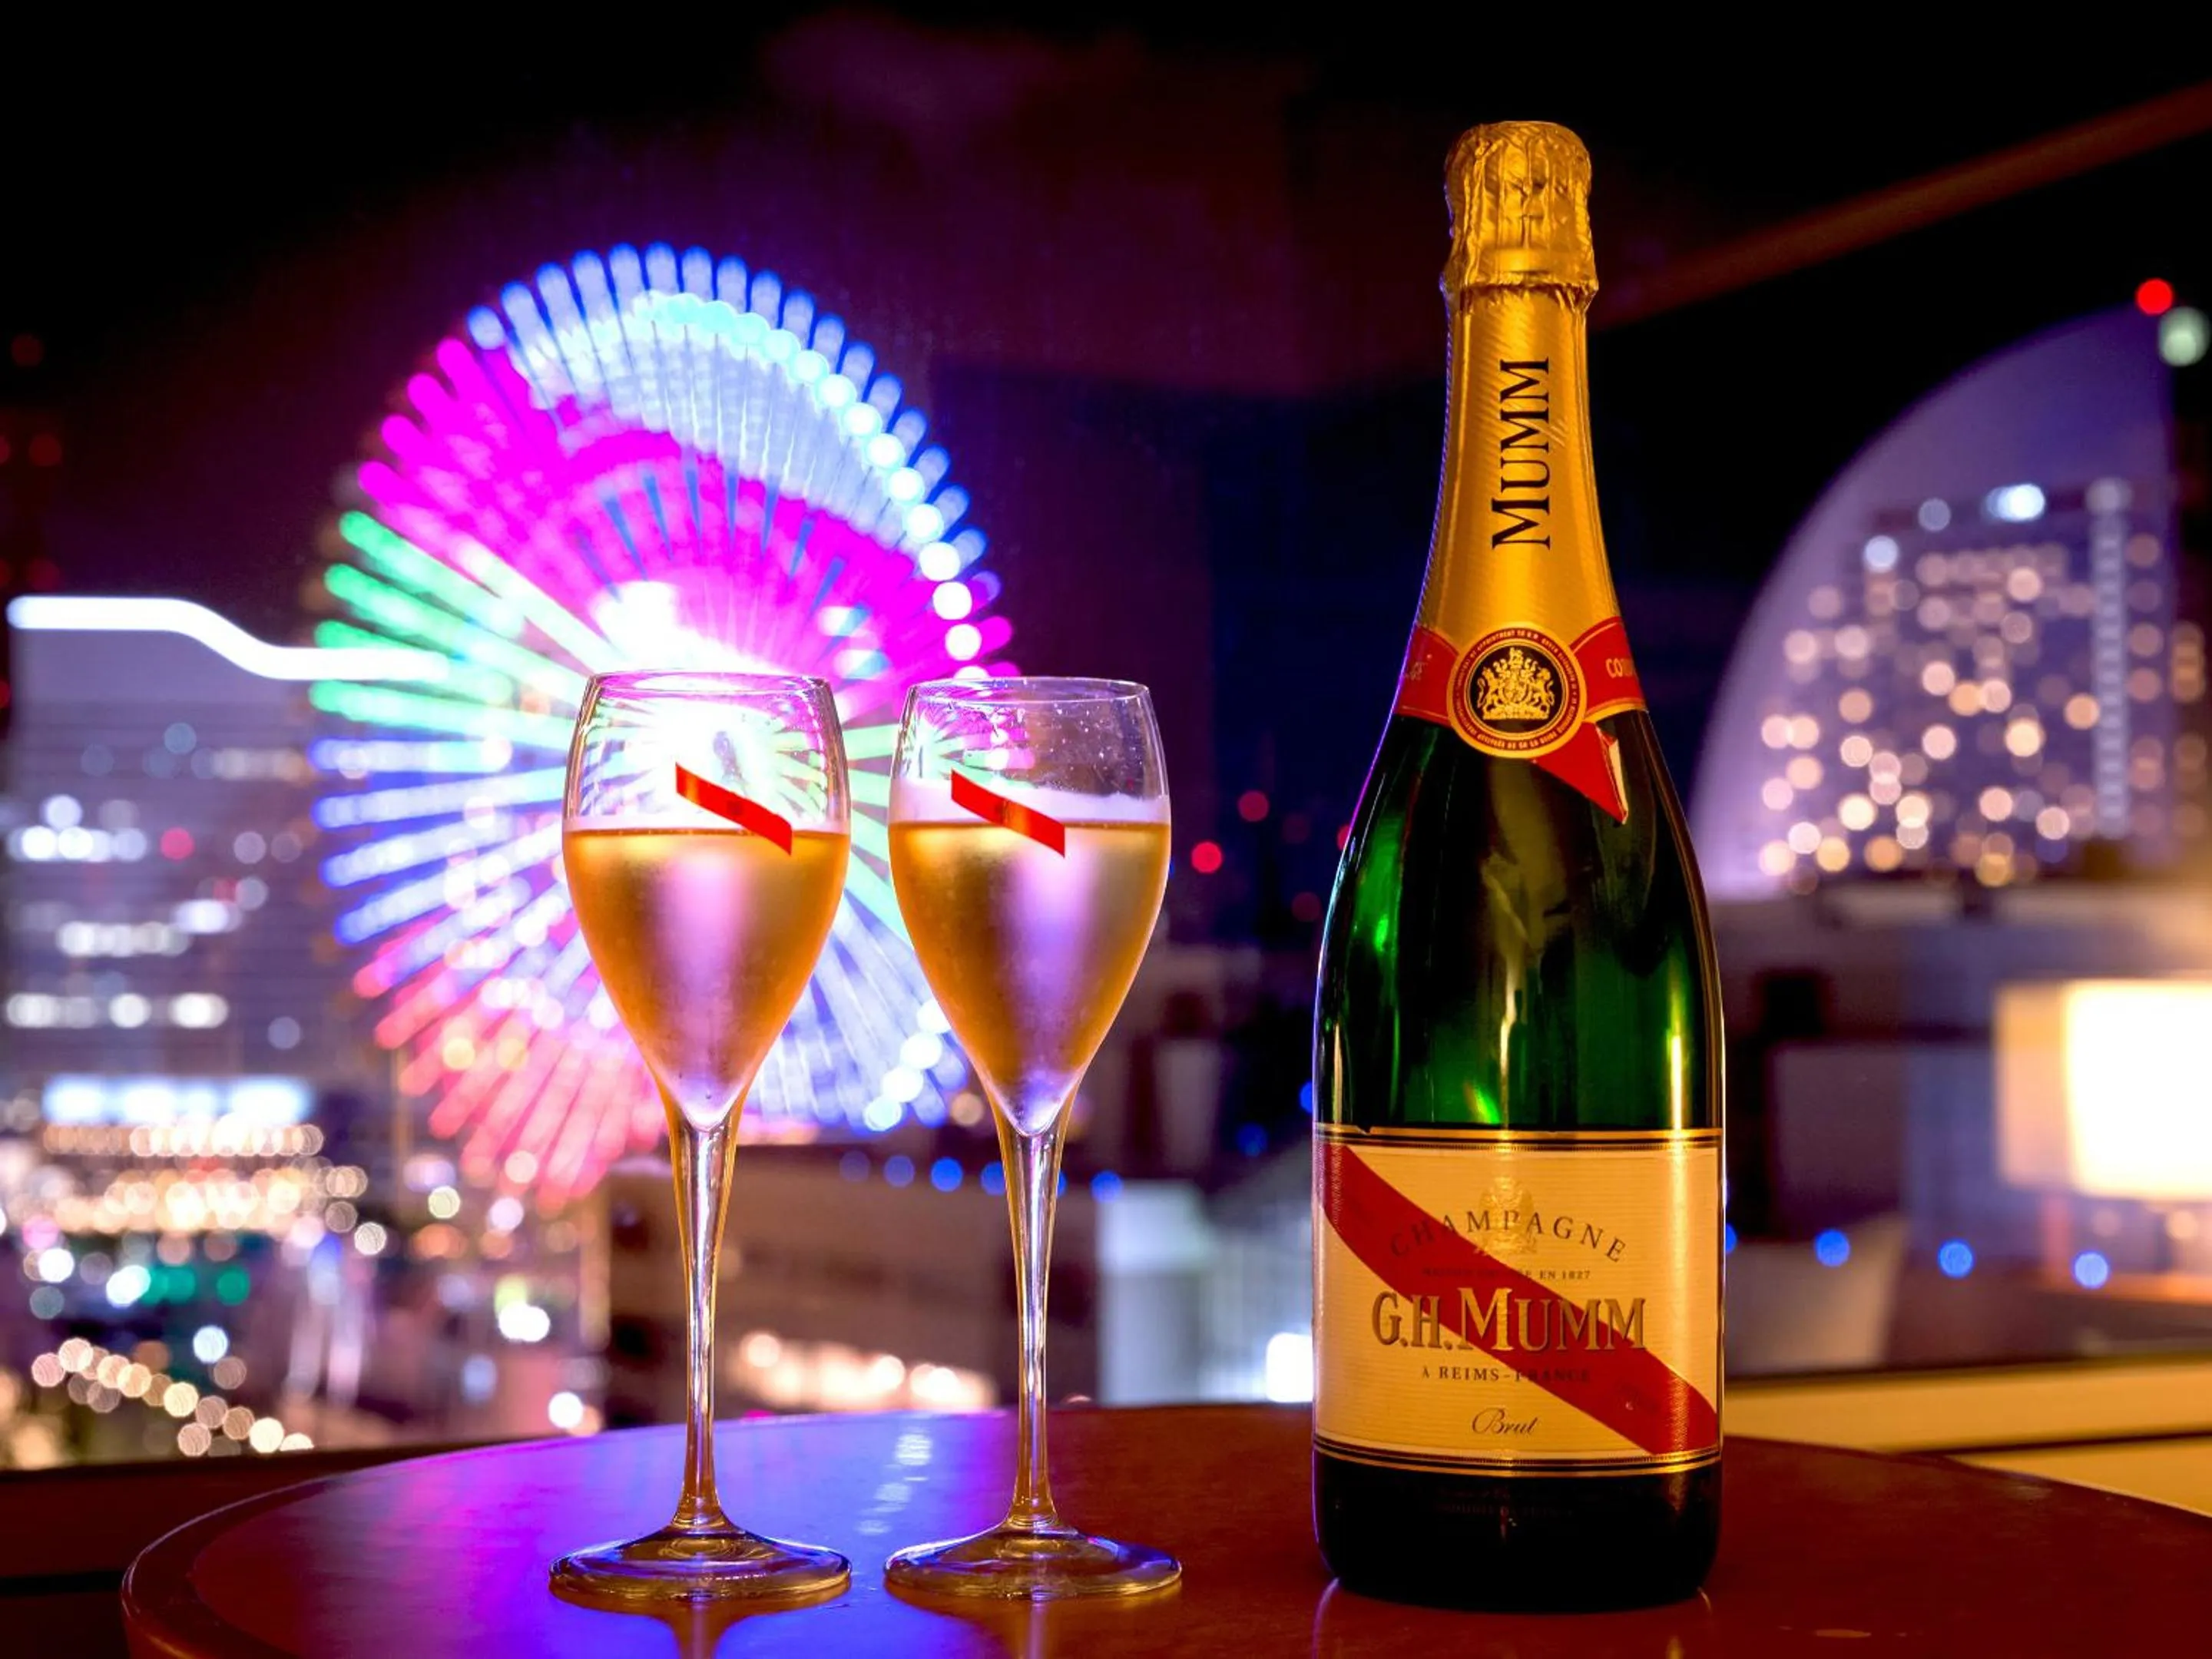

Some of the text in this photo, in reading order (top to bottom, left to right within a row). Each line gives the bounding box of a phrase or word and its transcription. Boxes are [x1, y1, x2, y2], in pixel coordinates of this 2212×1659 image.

[1492, 357, 1551, 550] MUMM
[1389, 1210, 1626, 1262] CHAMPAGNE
[1472, 1407, 1538, 1435] Brut
